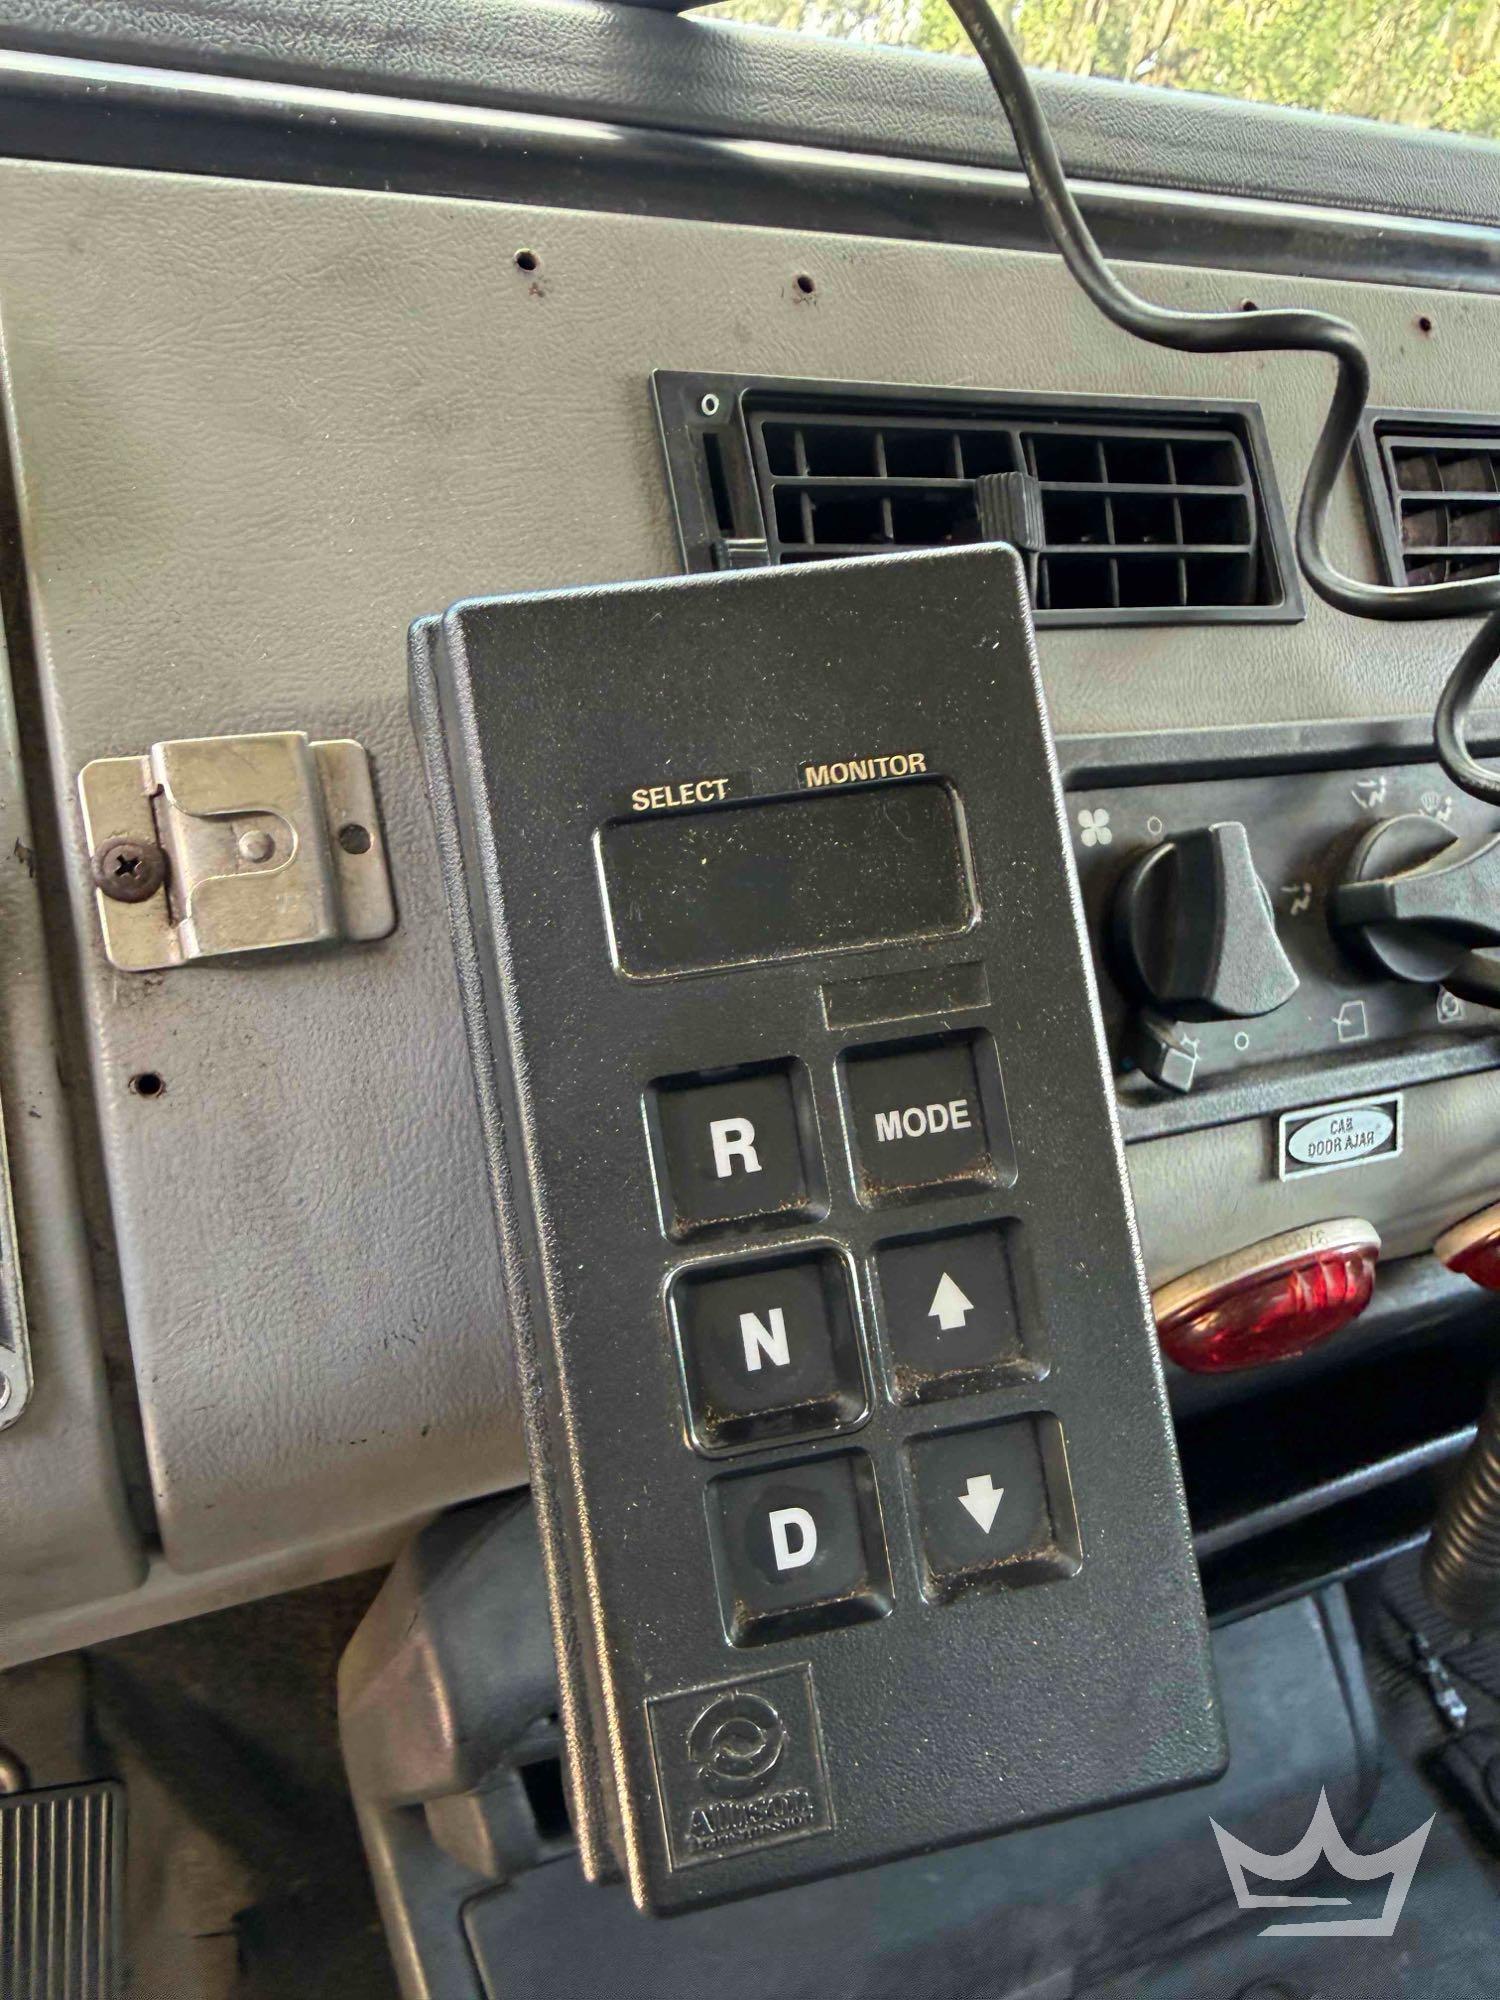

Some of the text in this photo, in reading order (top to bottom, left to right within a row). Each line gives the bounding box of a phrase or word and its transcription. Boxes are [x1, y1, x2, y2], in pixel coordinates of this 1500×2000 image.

[804, 752, 927, 788] MONITOR
[631, 778, 729, 812] SELECT
[874, 1099, 972, 1142] MODE
[1330, 1117, 1354, 1136] CAB
[709, 1117, 763, 1179] R
[1307, 1130, 1375, 1159] DOOR AJAR
[739, 1307, 791, 1372] N
[768, 1507, 818, 1571] D
